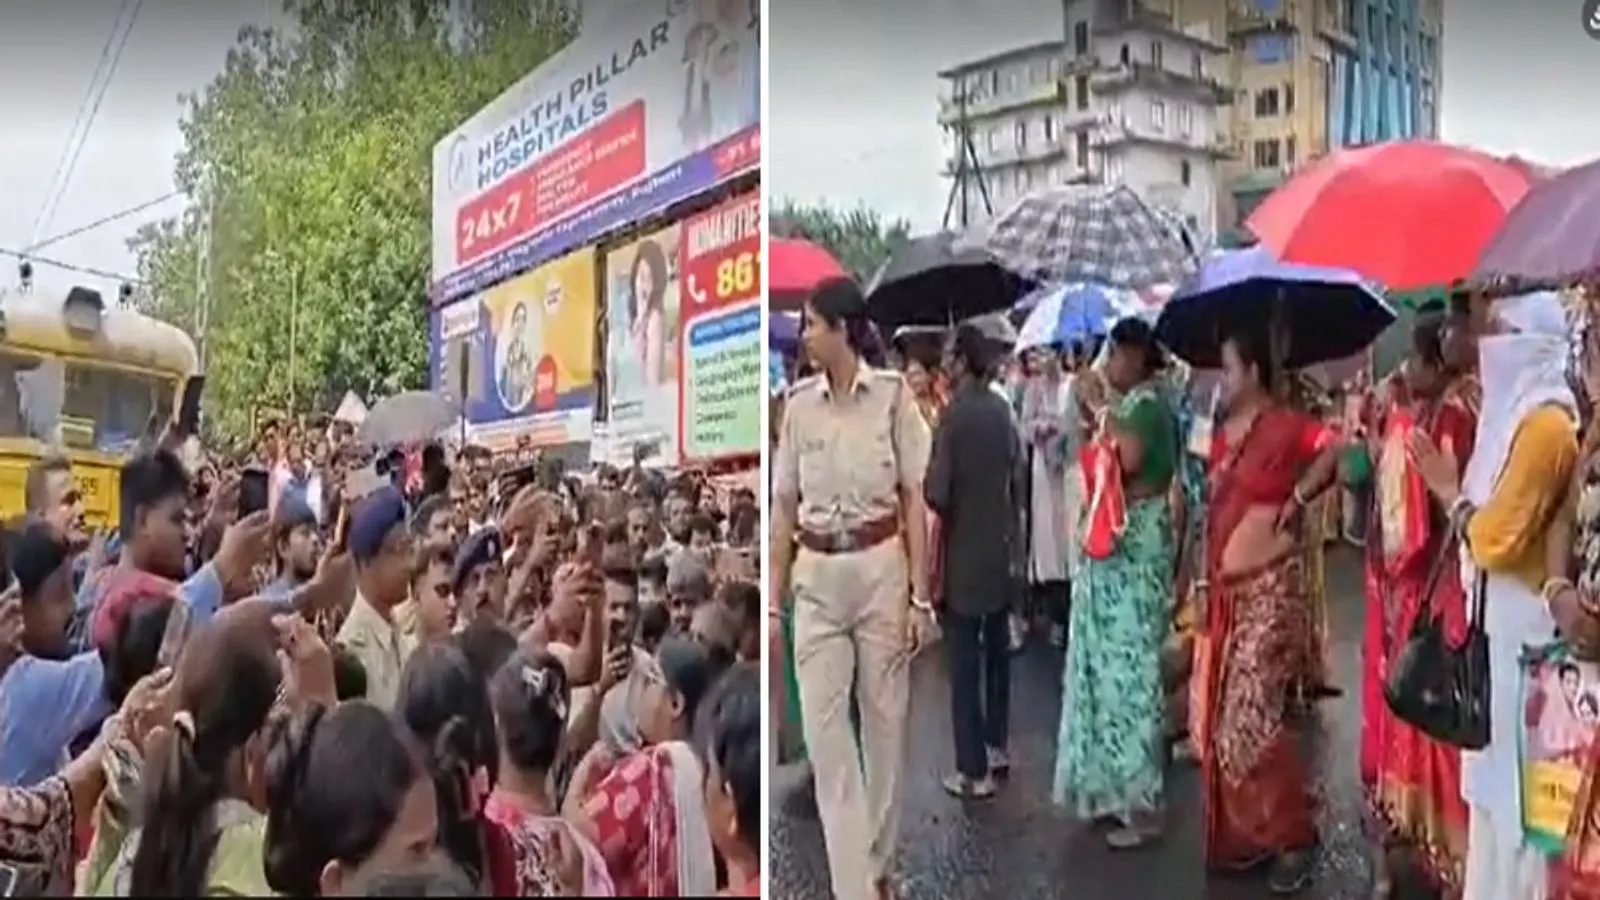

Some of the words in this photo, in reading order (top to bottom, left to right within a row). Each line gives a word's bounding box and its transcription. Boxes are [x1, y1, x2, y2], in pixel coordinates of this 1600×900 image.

[478, 90, 562, 165] HEALTH
[570, 21, 669, 102] PILLAR
[477, 91, 608, 189] HOSPITALS
[462, 190, 523, 249] 24x7
[716, 252, 761, 298] 86
